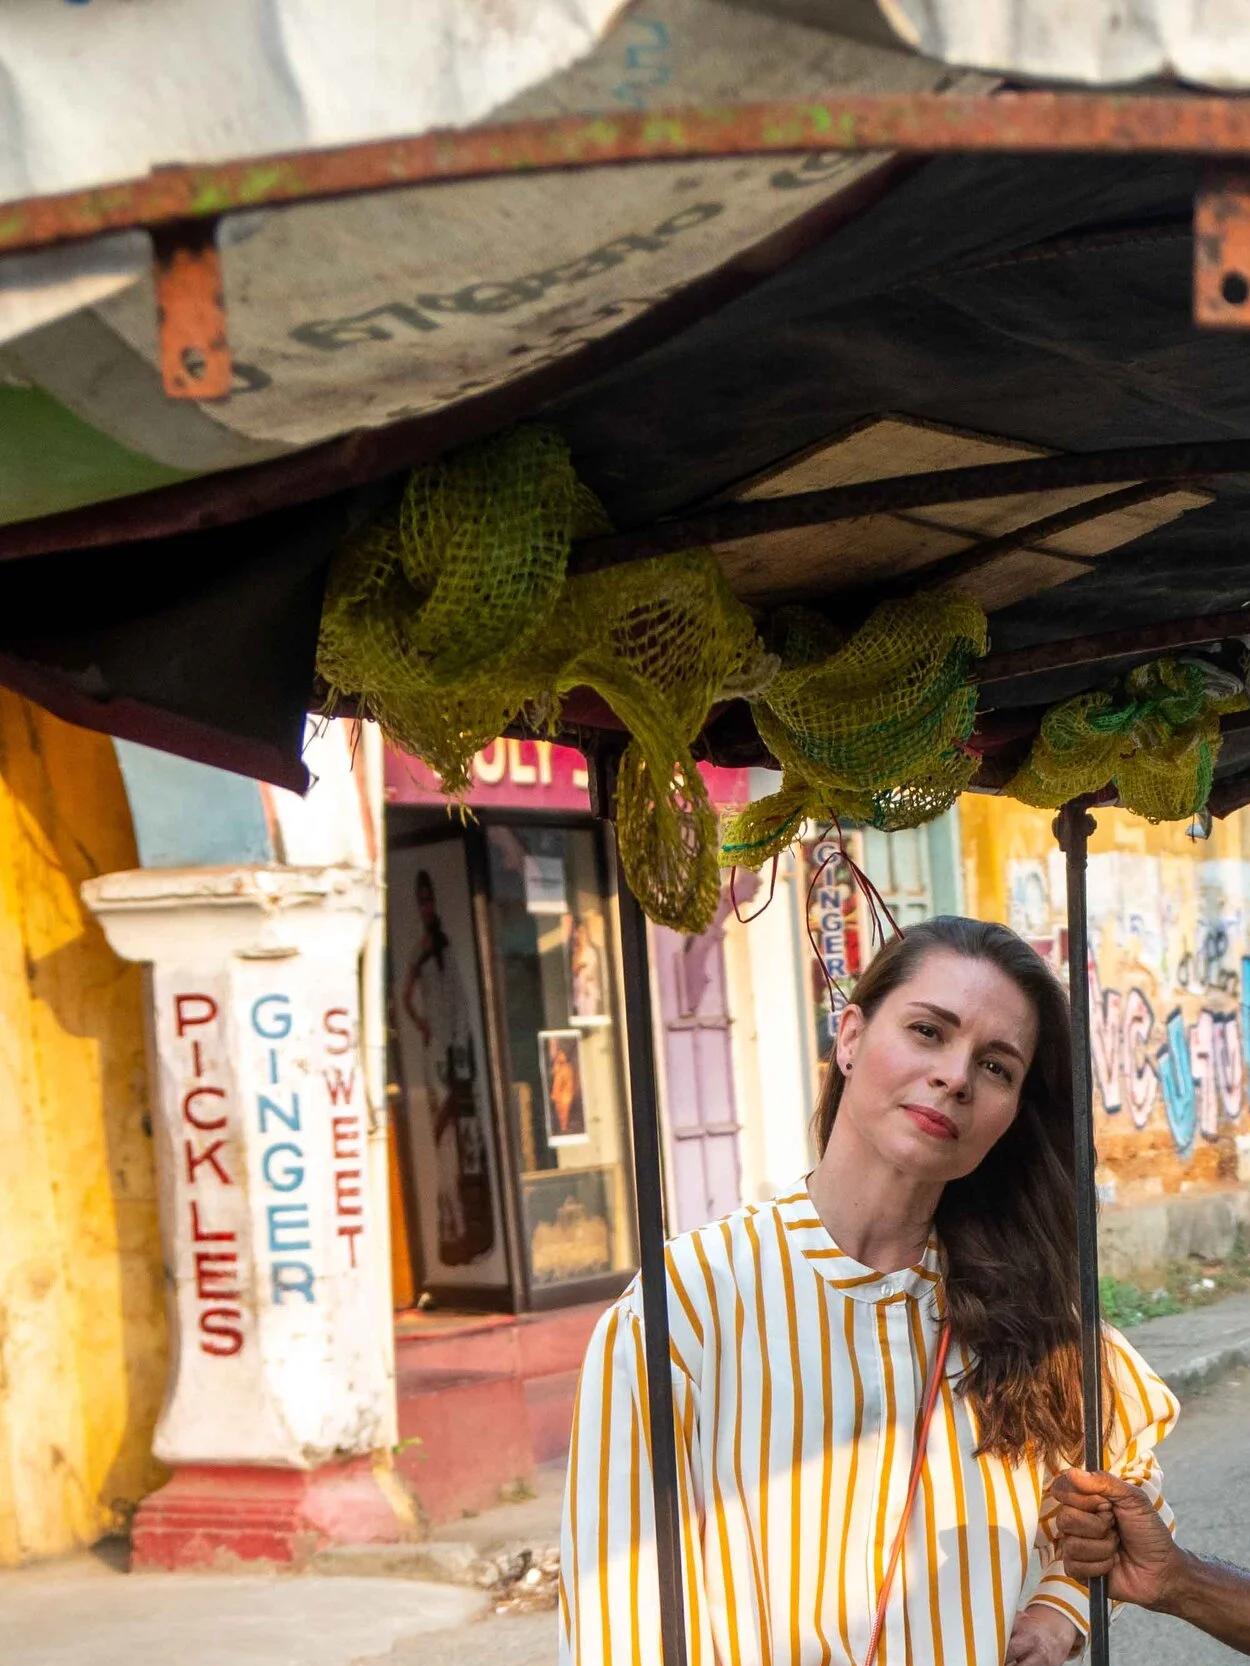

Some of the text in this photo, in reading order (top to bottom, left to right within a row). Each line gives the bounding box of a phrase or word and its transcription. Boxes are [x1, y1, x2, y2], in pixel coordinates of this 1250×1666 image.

[816, 845, 846, 977] GINGER
[173, 993, 244, 1357] PICKLES
[250, 993, 316, 1305] GINGER
[321, 1006, 364, 1269] SWEET
